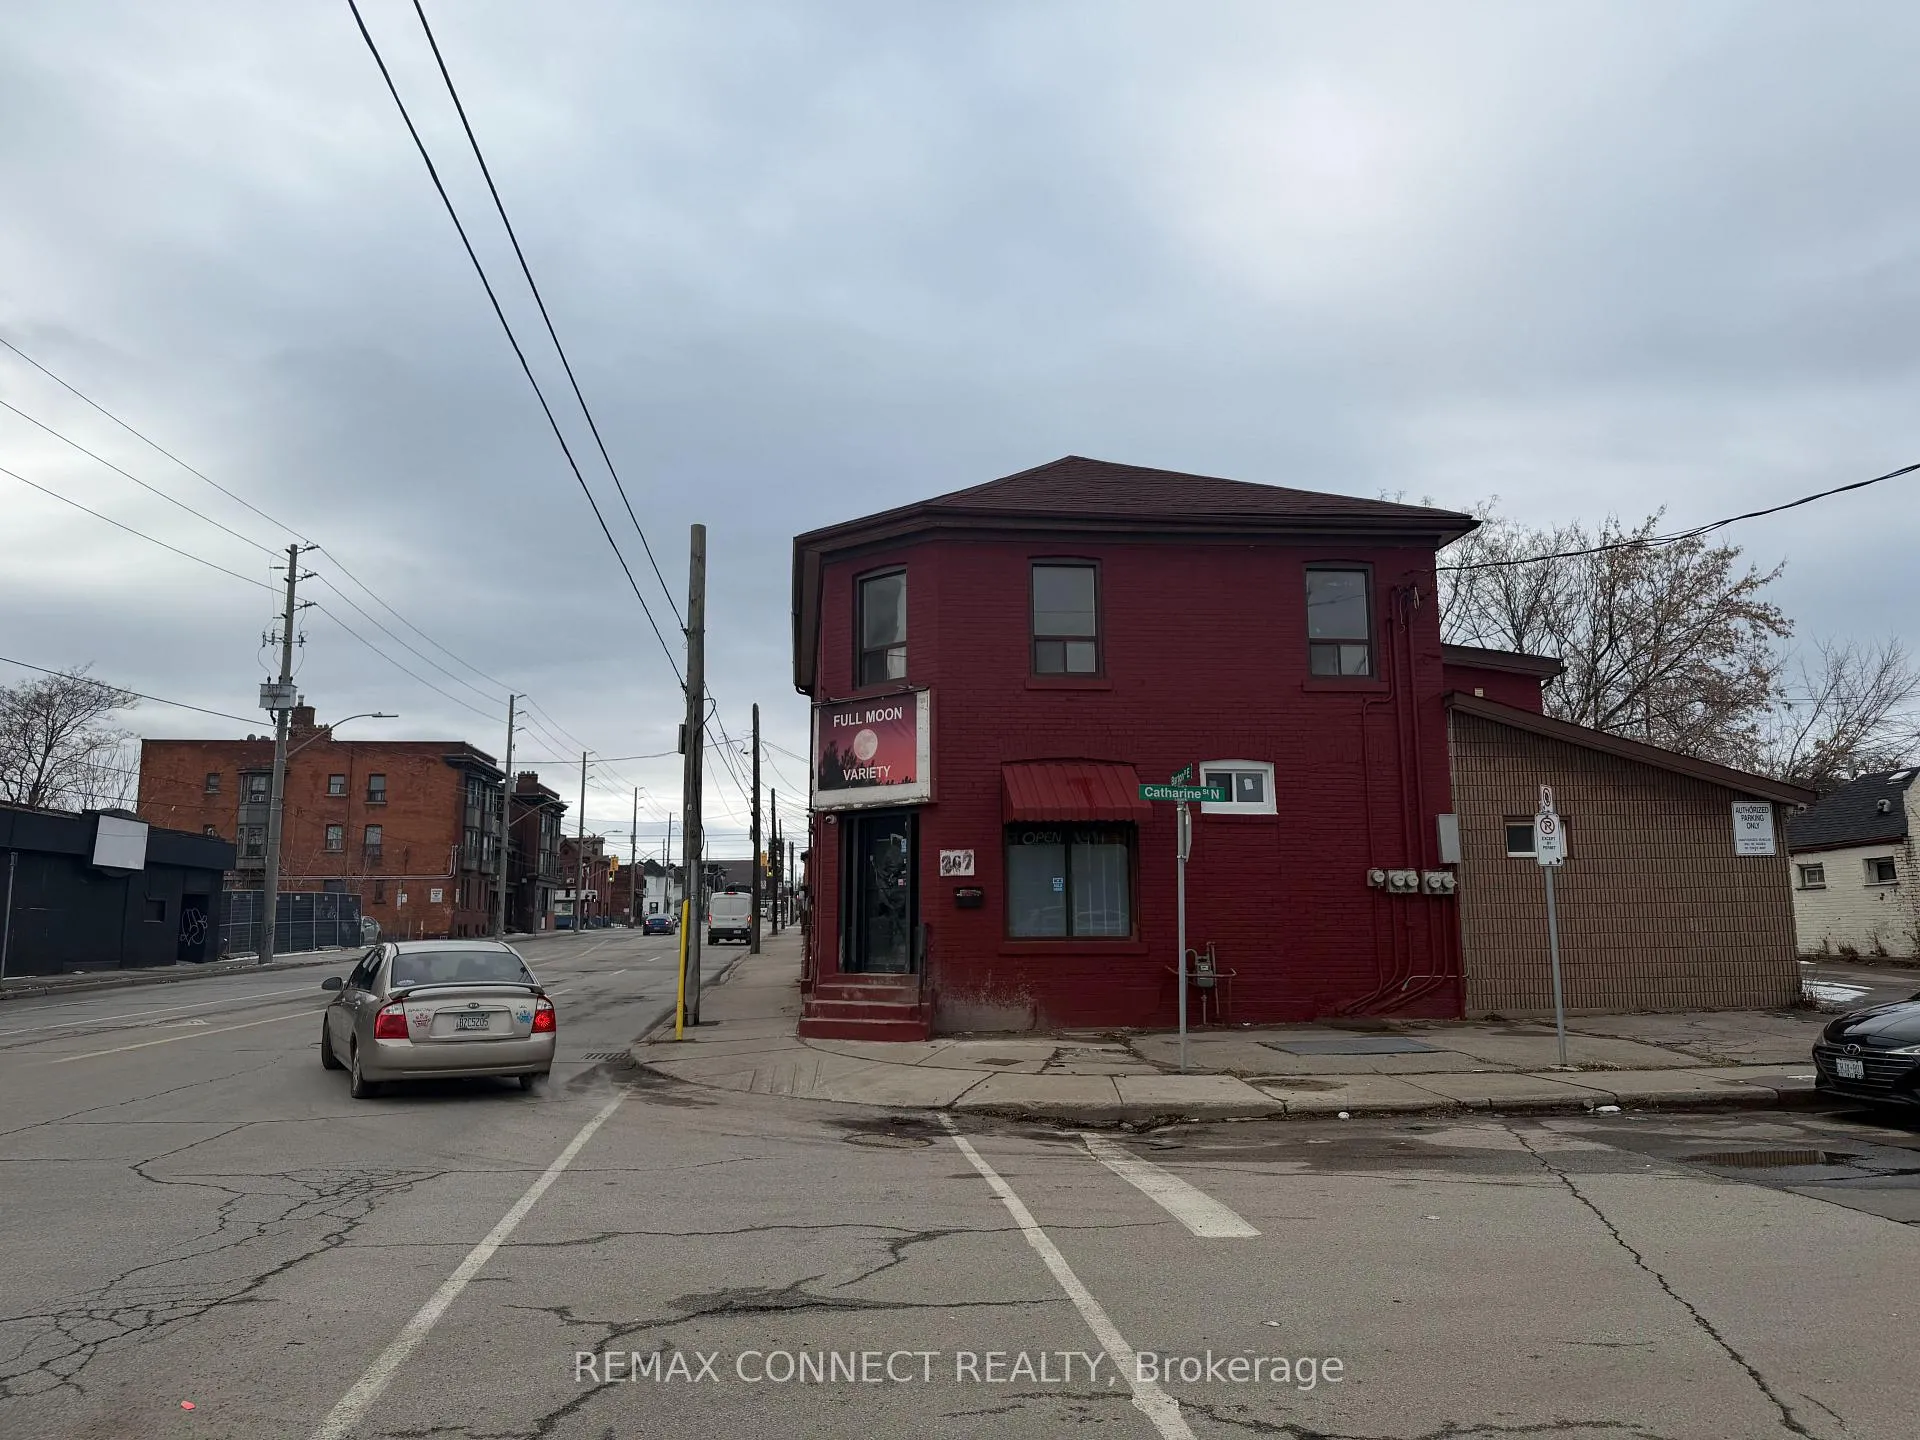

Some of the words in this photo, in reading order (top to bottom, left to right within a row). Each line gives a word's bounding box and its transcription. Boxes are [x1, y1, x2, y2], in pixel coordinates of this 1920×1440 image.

[833, 713, 863, 727] FULL
[865, 707, 903, 723] MOON
[843, 765, 891, 781] VARIETY
[1186, 768, 1190, 778] E
[1144, 787, 1202, 799] Catharine
[1211, 789, 1220, 799] N
[1022, 830, 1062, 845] OPEN
